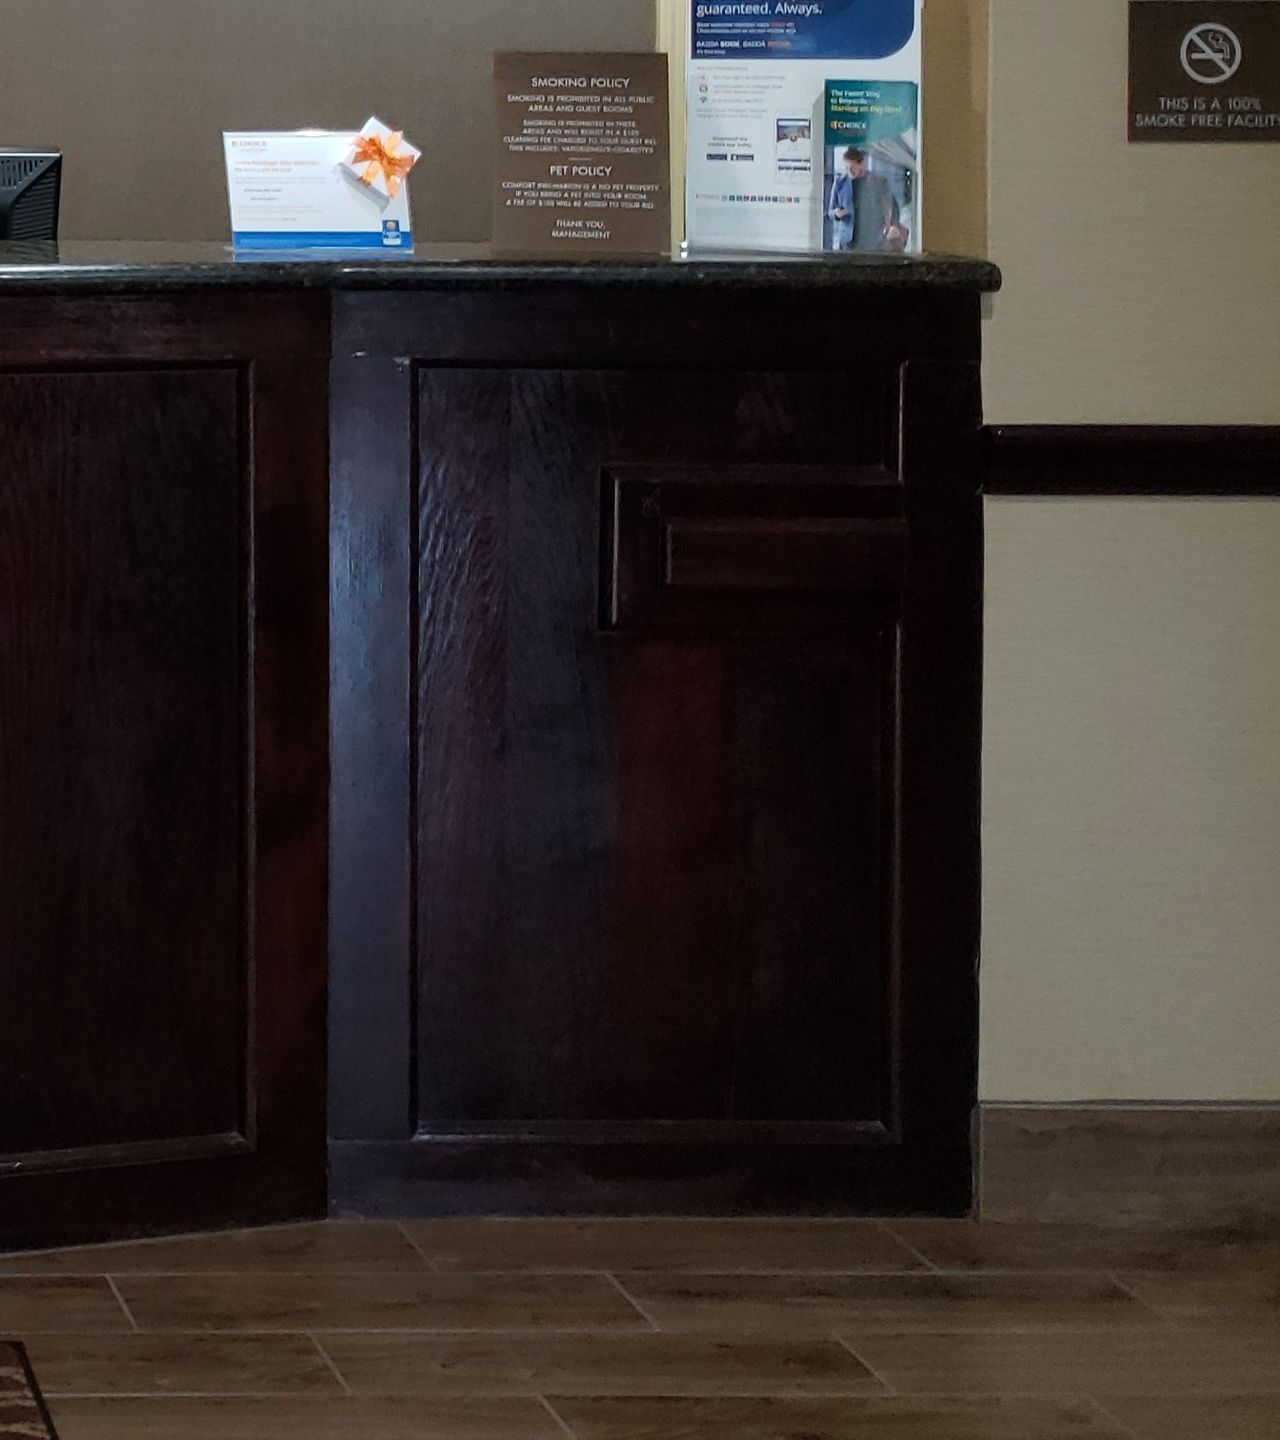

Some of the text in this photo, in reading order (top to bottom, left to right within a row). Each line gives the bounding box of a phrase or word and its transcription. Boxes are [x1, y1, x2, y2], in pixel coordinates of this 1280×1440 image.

[696, 2, 823, 18] guaranteed. Always.
[530, 76, 632, 89] SMOKING POLICY
[831, 89, 844, 97] The
[507, 95, 545, 103] SMOKING
[546, 95, 555, 103] IS
[556, 95, 601, 103] PROHIBITED
[628, 96, 655, 104] PUBLIC
[1158, 96, 1262, 111] THIS IS A 100%
[1135, 113, 1186, 128] SMOKE
[1191, 114, 1223, 128] FREE
[549, 165, 613, 177] PET POLICY
[556, 219, 583, 228] THANK
[551, 229, 611, 239] MANAGEMENT
